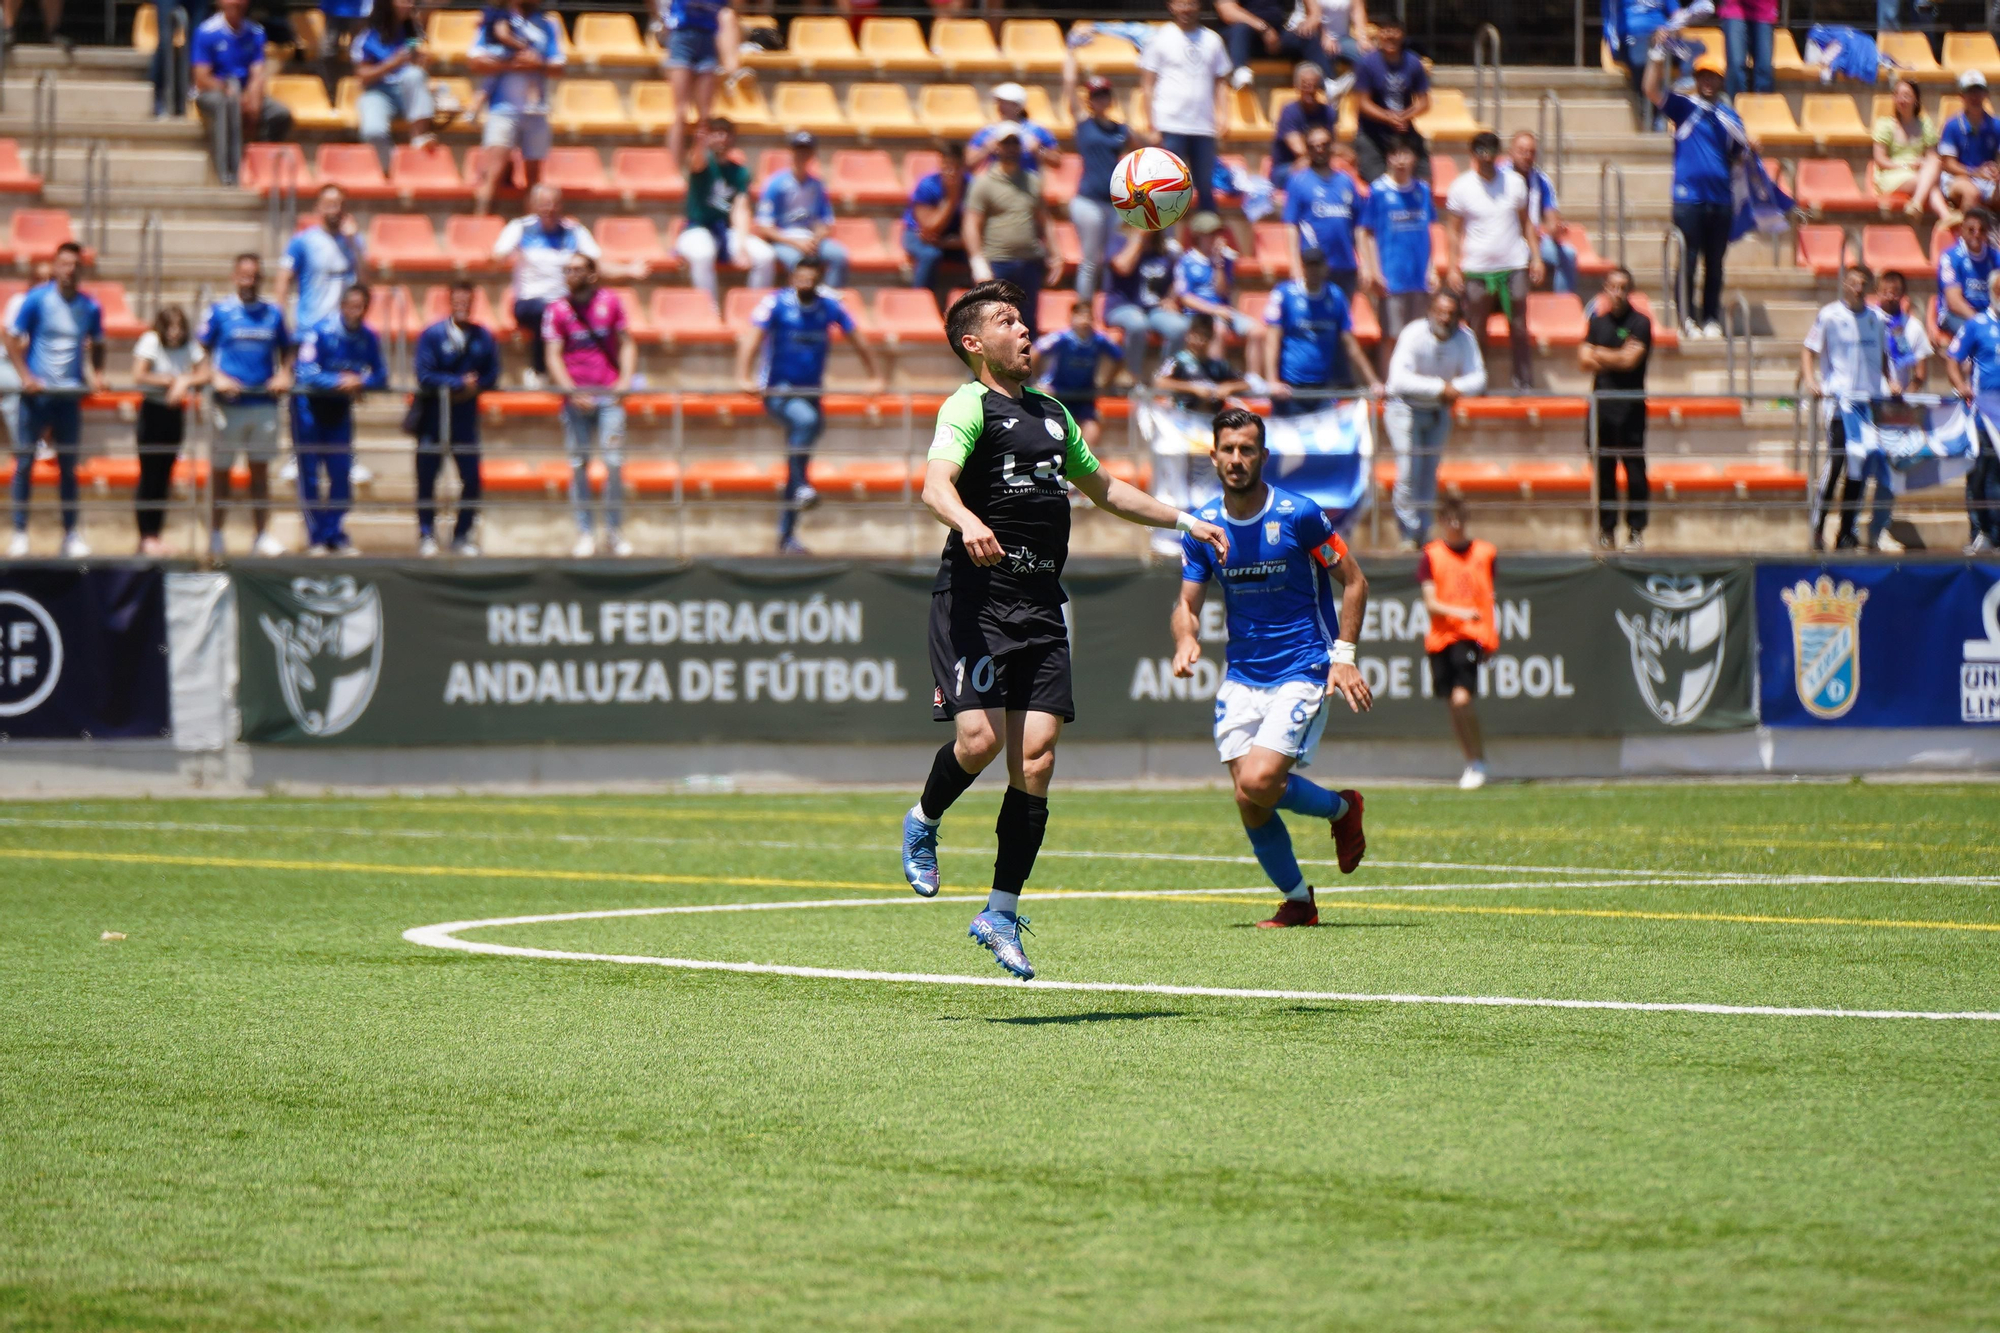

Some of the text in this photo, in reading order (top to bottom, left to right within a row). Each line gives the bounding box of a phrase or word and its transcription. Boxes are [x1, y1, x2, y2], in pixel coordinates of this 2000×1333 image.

[1221, 564, 1287, 577] Torralva
[487, 592, 863, 644] REAL FEDERACIÓN
[444, 650, 907, 703] ANDALUZA DE FÚTBOL
[954, 655, 995, 697] 10
[1358, 656, 1412, 699] DE
[1290, 699, 1307, 725] 6
